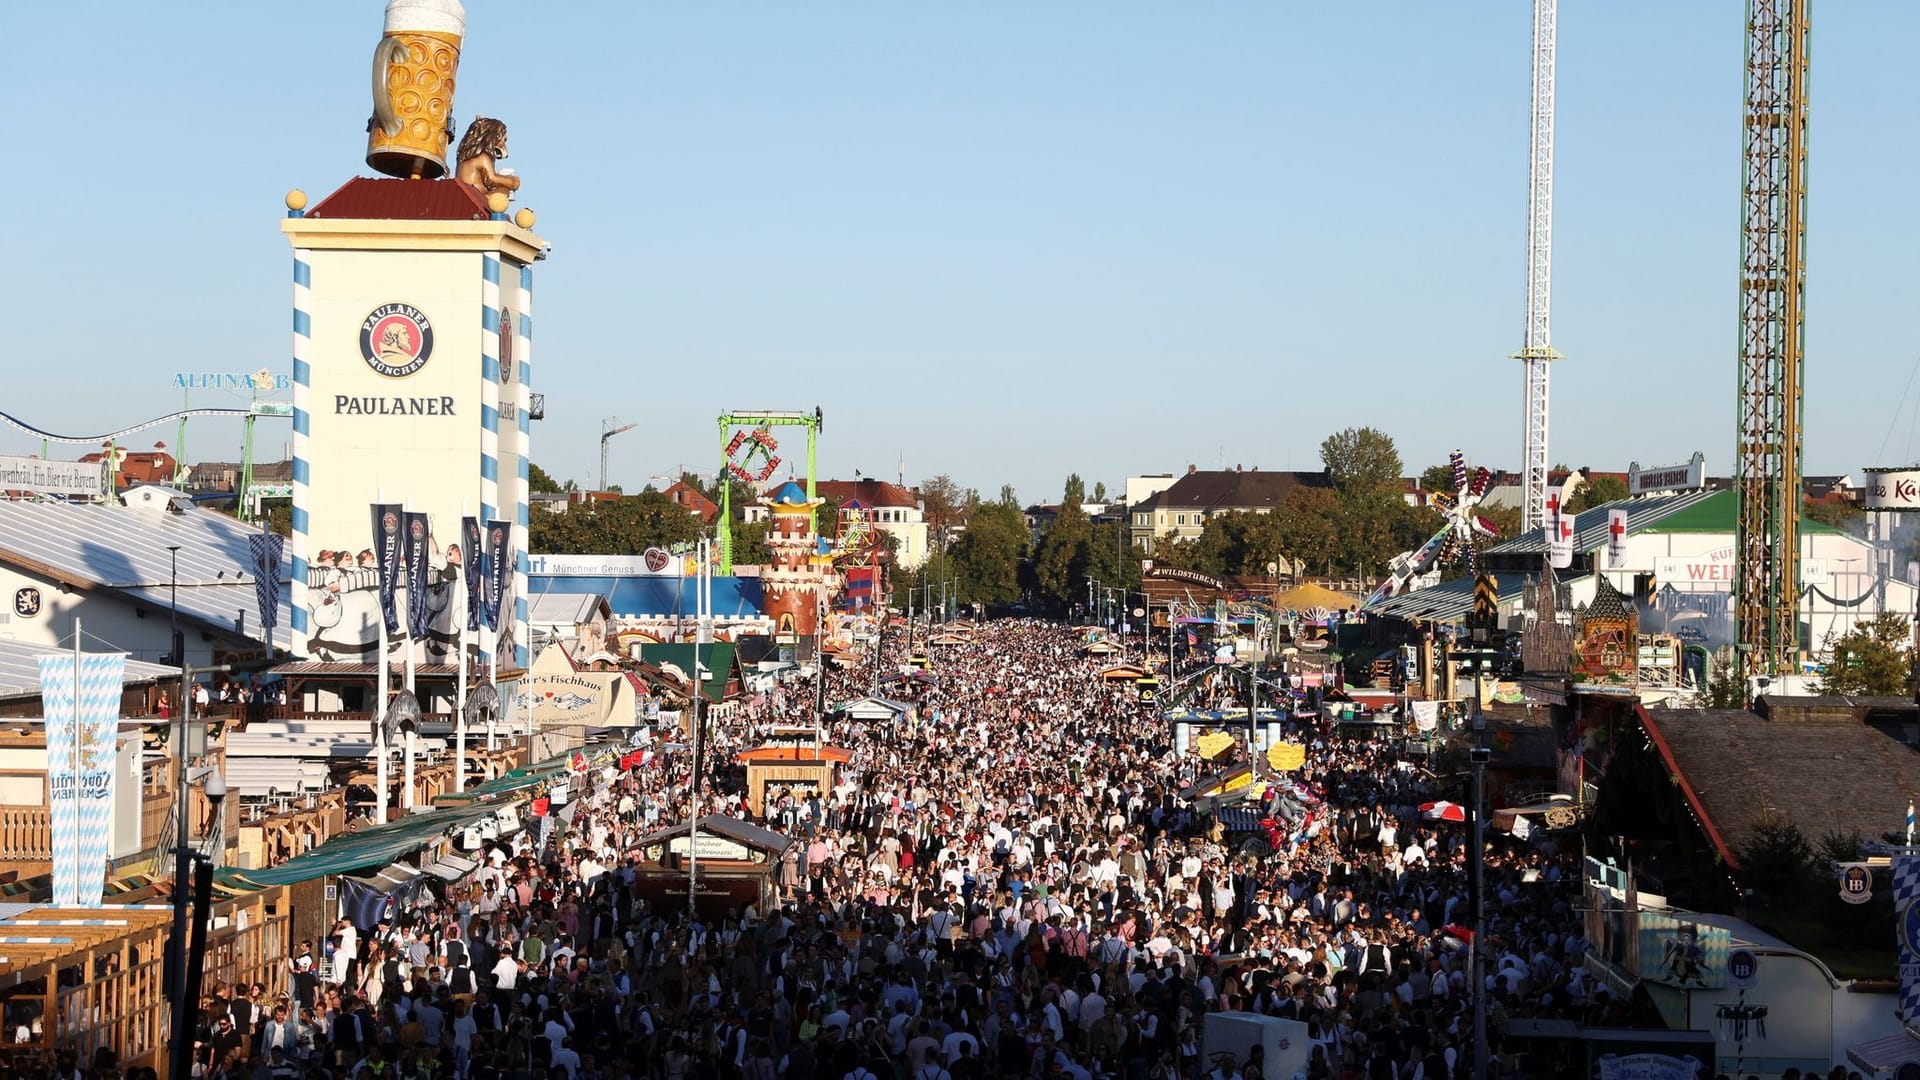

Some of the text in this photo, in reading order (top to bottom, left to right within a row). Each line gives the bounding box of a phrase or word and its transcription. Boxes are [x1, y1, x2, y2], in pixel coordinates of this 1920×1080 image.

[363, 303, 430, 332] PAULANER
[368, 356, 425, 376] MÜNCHEN
[171, 372, 254, 389] ALPINA
[334, 394, 457, 416] PAULANER
[1895, 479, 1920, 502] Kä
[553, 564, 597, 574] Münchner
[601, 565, 635, 574] Genuss
[550, 674, 602, 693] Fischhaus
[1849, 879, 1863, 892] HB
